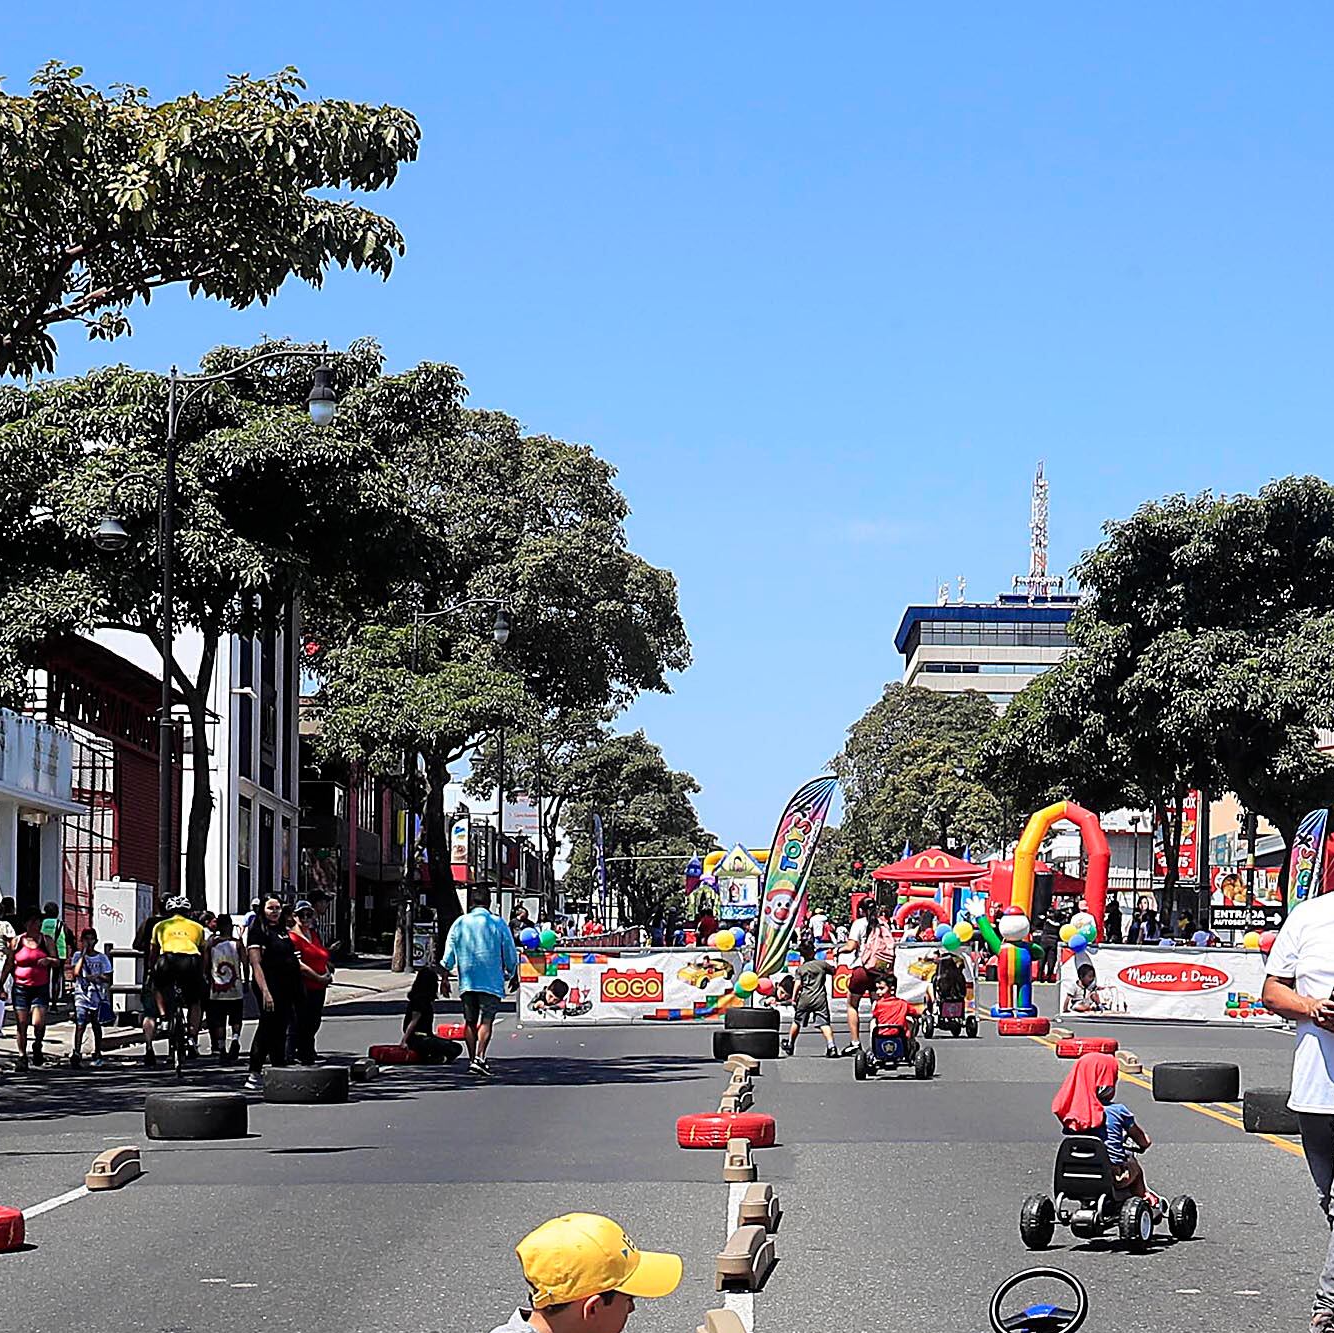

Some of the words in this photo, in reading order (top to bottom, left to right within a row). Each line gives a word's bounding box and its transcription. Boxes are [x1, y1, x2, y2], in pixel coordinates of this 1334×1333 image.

[779, 815, 812, 872] TOYS
[1126, 967, 1178, 984] Melissa
[602, 977, 663, 998] COGO
